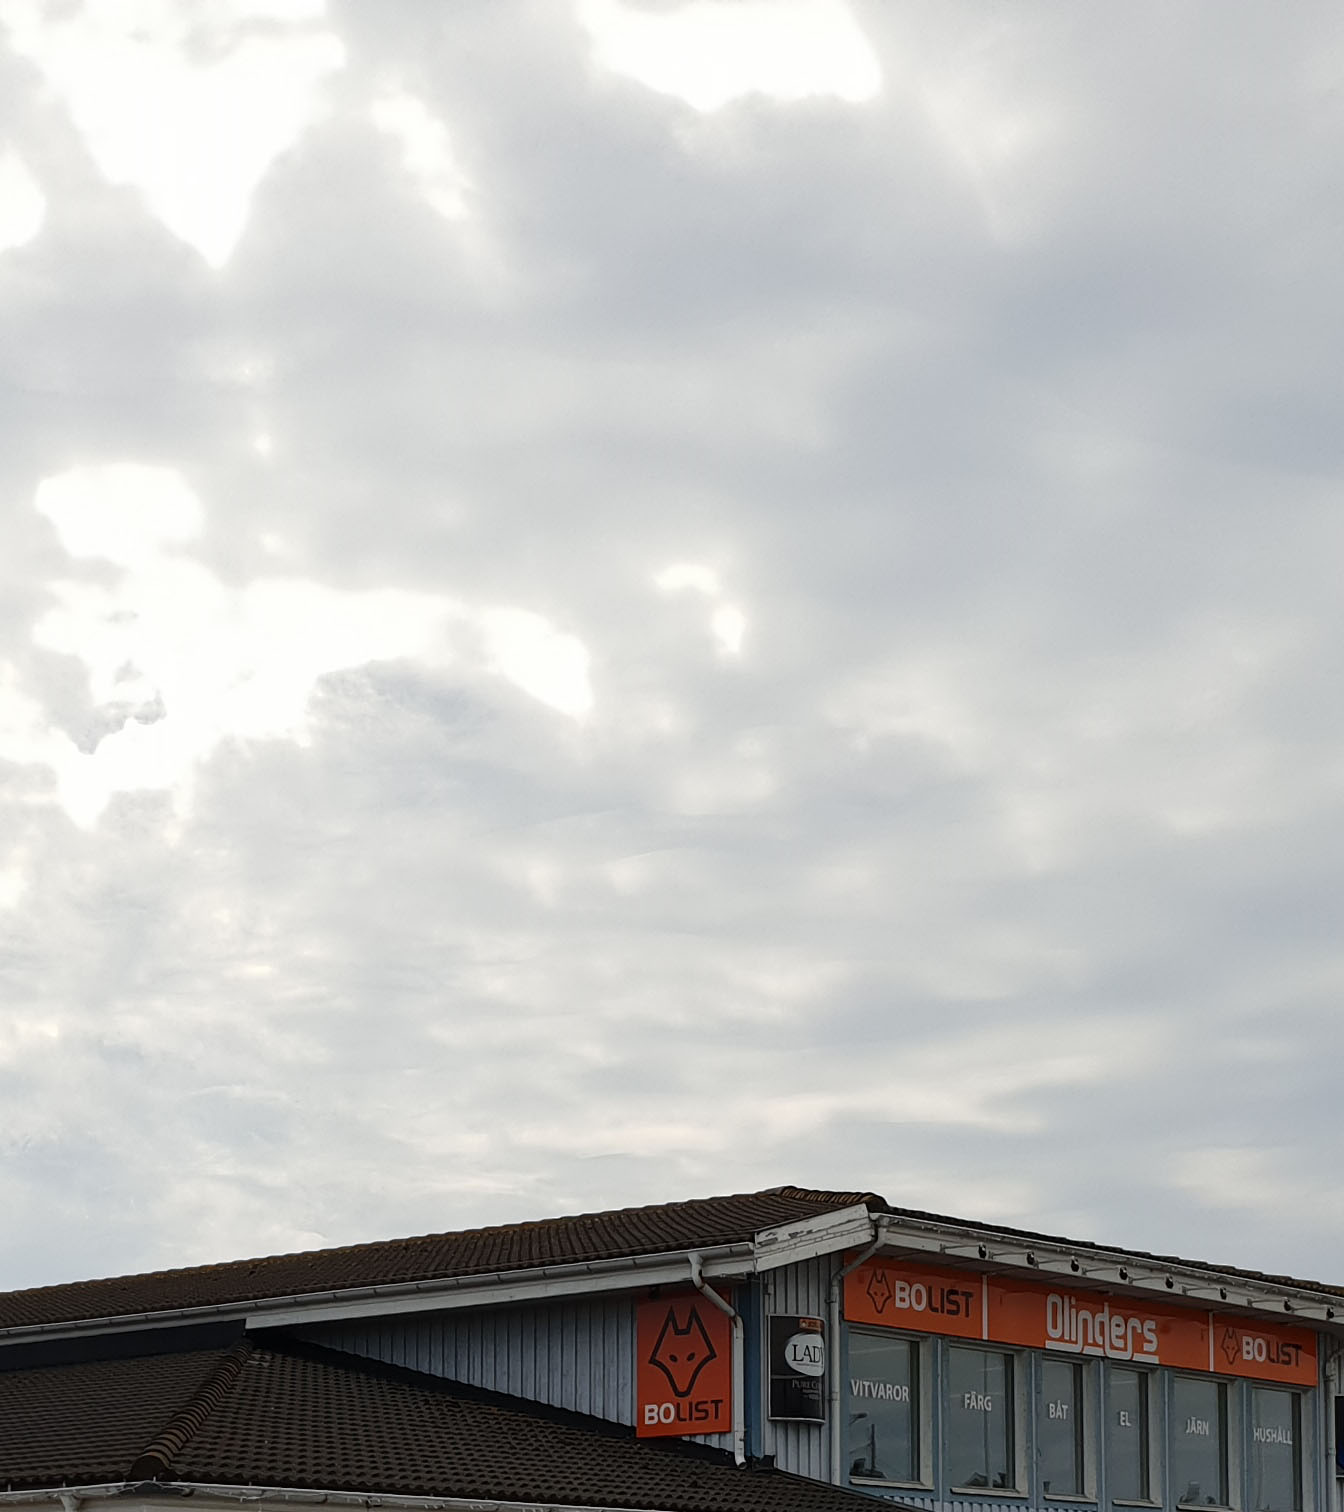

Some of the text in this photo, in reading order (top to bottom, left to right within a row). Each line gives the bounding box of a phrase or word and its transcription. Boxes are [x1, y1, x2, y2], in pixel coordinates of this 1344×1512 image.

[895, 1280, 974, 1318] BOLIST
[1045, 1293, 1159, 1364] Olinders
[1242, 1336, 1303, 1367] BOLIST
[851, 1379, 910, 1402] VITVAROR
[644, 1400, 723, 1425] BOLIST
[964, 1392, 992, 1412] FÄRG
[1049, 1400, 1068, 1420] BÅT
[1120, 1411, 1131, 1427] EL
[1186, 1417, 1209, 1435] JÄRN
[1253, 1425, 1292, 1445] HUSHÅLL
